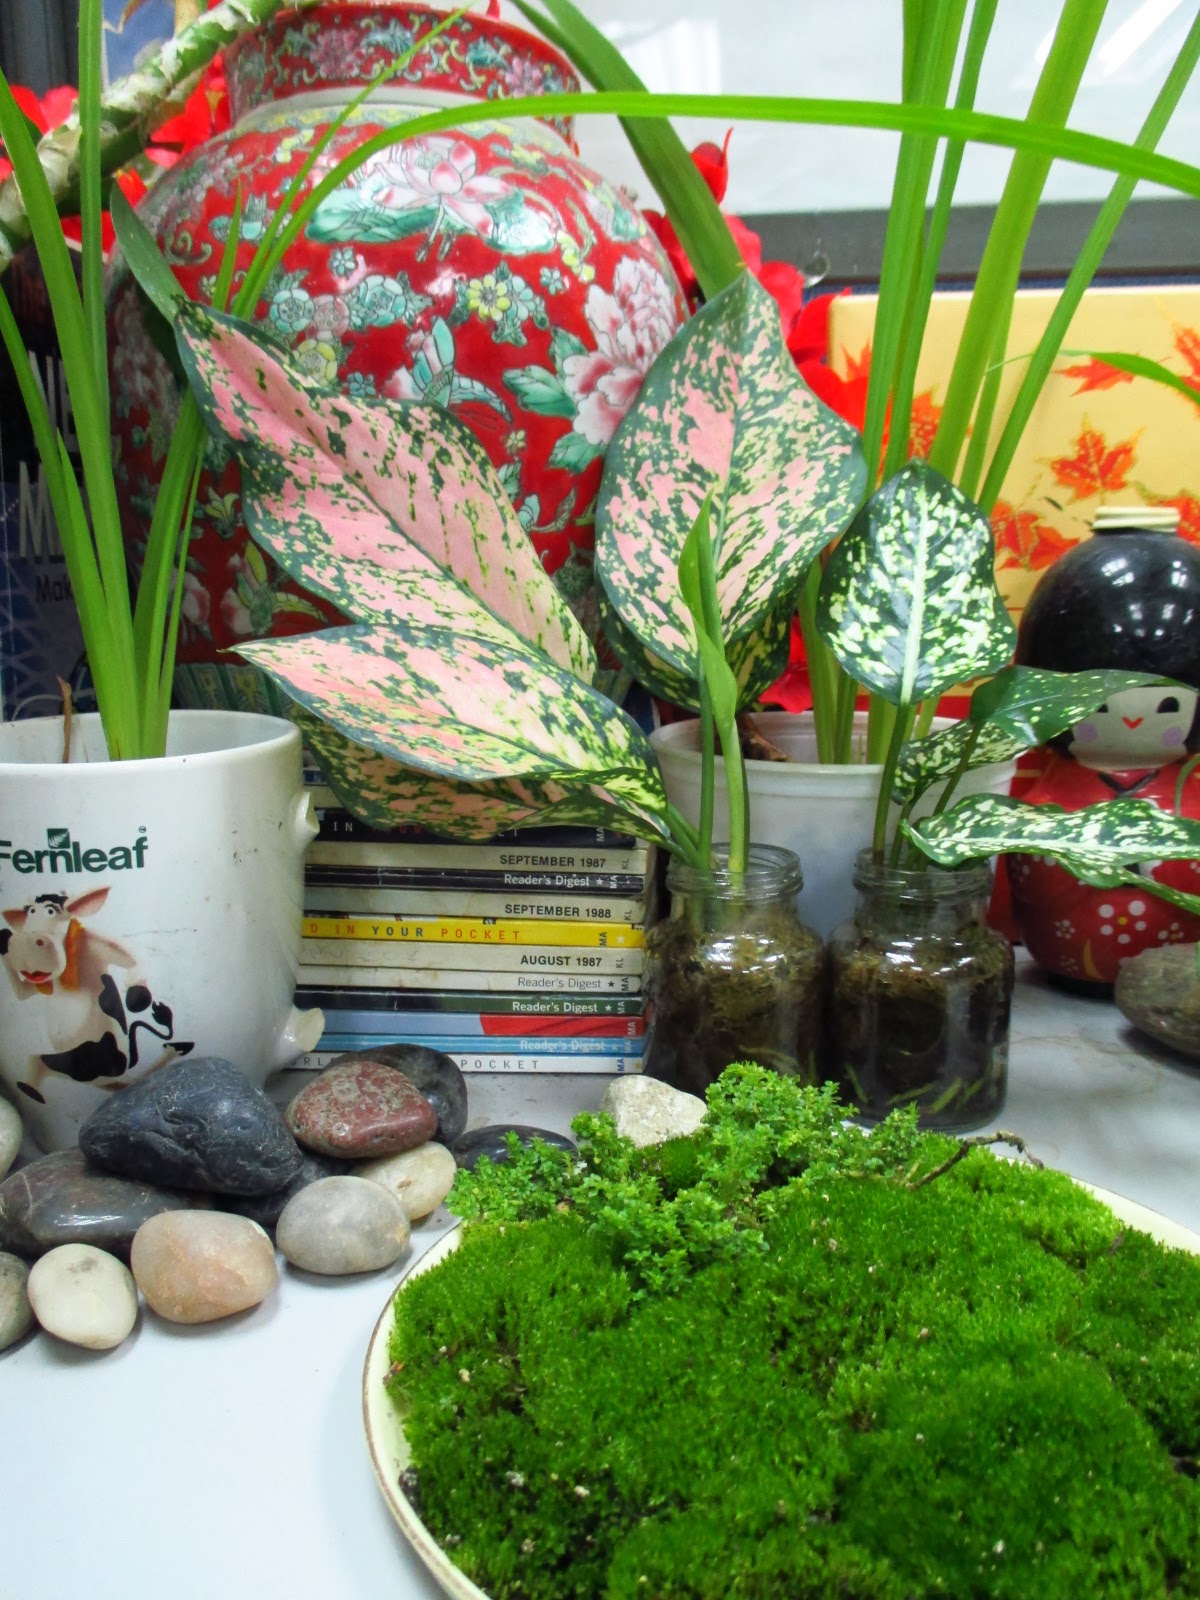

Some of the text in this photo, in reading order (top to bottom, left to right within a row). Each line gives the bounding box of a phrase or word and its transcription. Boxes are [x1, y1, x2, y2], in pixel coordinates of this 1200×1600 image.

[500, 854, 607, 868] SEPTEMBER 1987
[622, 859, 629, 870] KL
[504, 873, 590, 888] Reader's Digest
[610, 875, 618, 889] MA
[505, 903, 612, 919] SEPTEMBER 1988
[624, 910, 632, 921] KL
[336, 924, 355, 935] IN
[372, 925, 424, 937] YOUR
[441, 927, 520, 941] POCKET
[599, 931, 608, 947] MA
[520, 955, 602, 967] AUGUST 1987
[616, 958, 624, 969] KL
[517, 976, 602, 990] Reader's Digest
[621, 977, 630, 992] MA
[512, 1001, 598, 1014] Reader's Digest
[519, 1040, 605, 1053] Reader's Digest
[460, 1059, 539, 1070] POCKET
